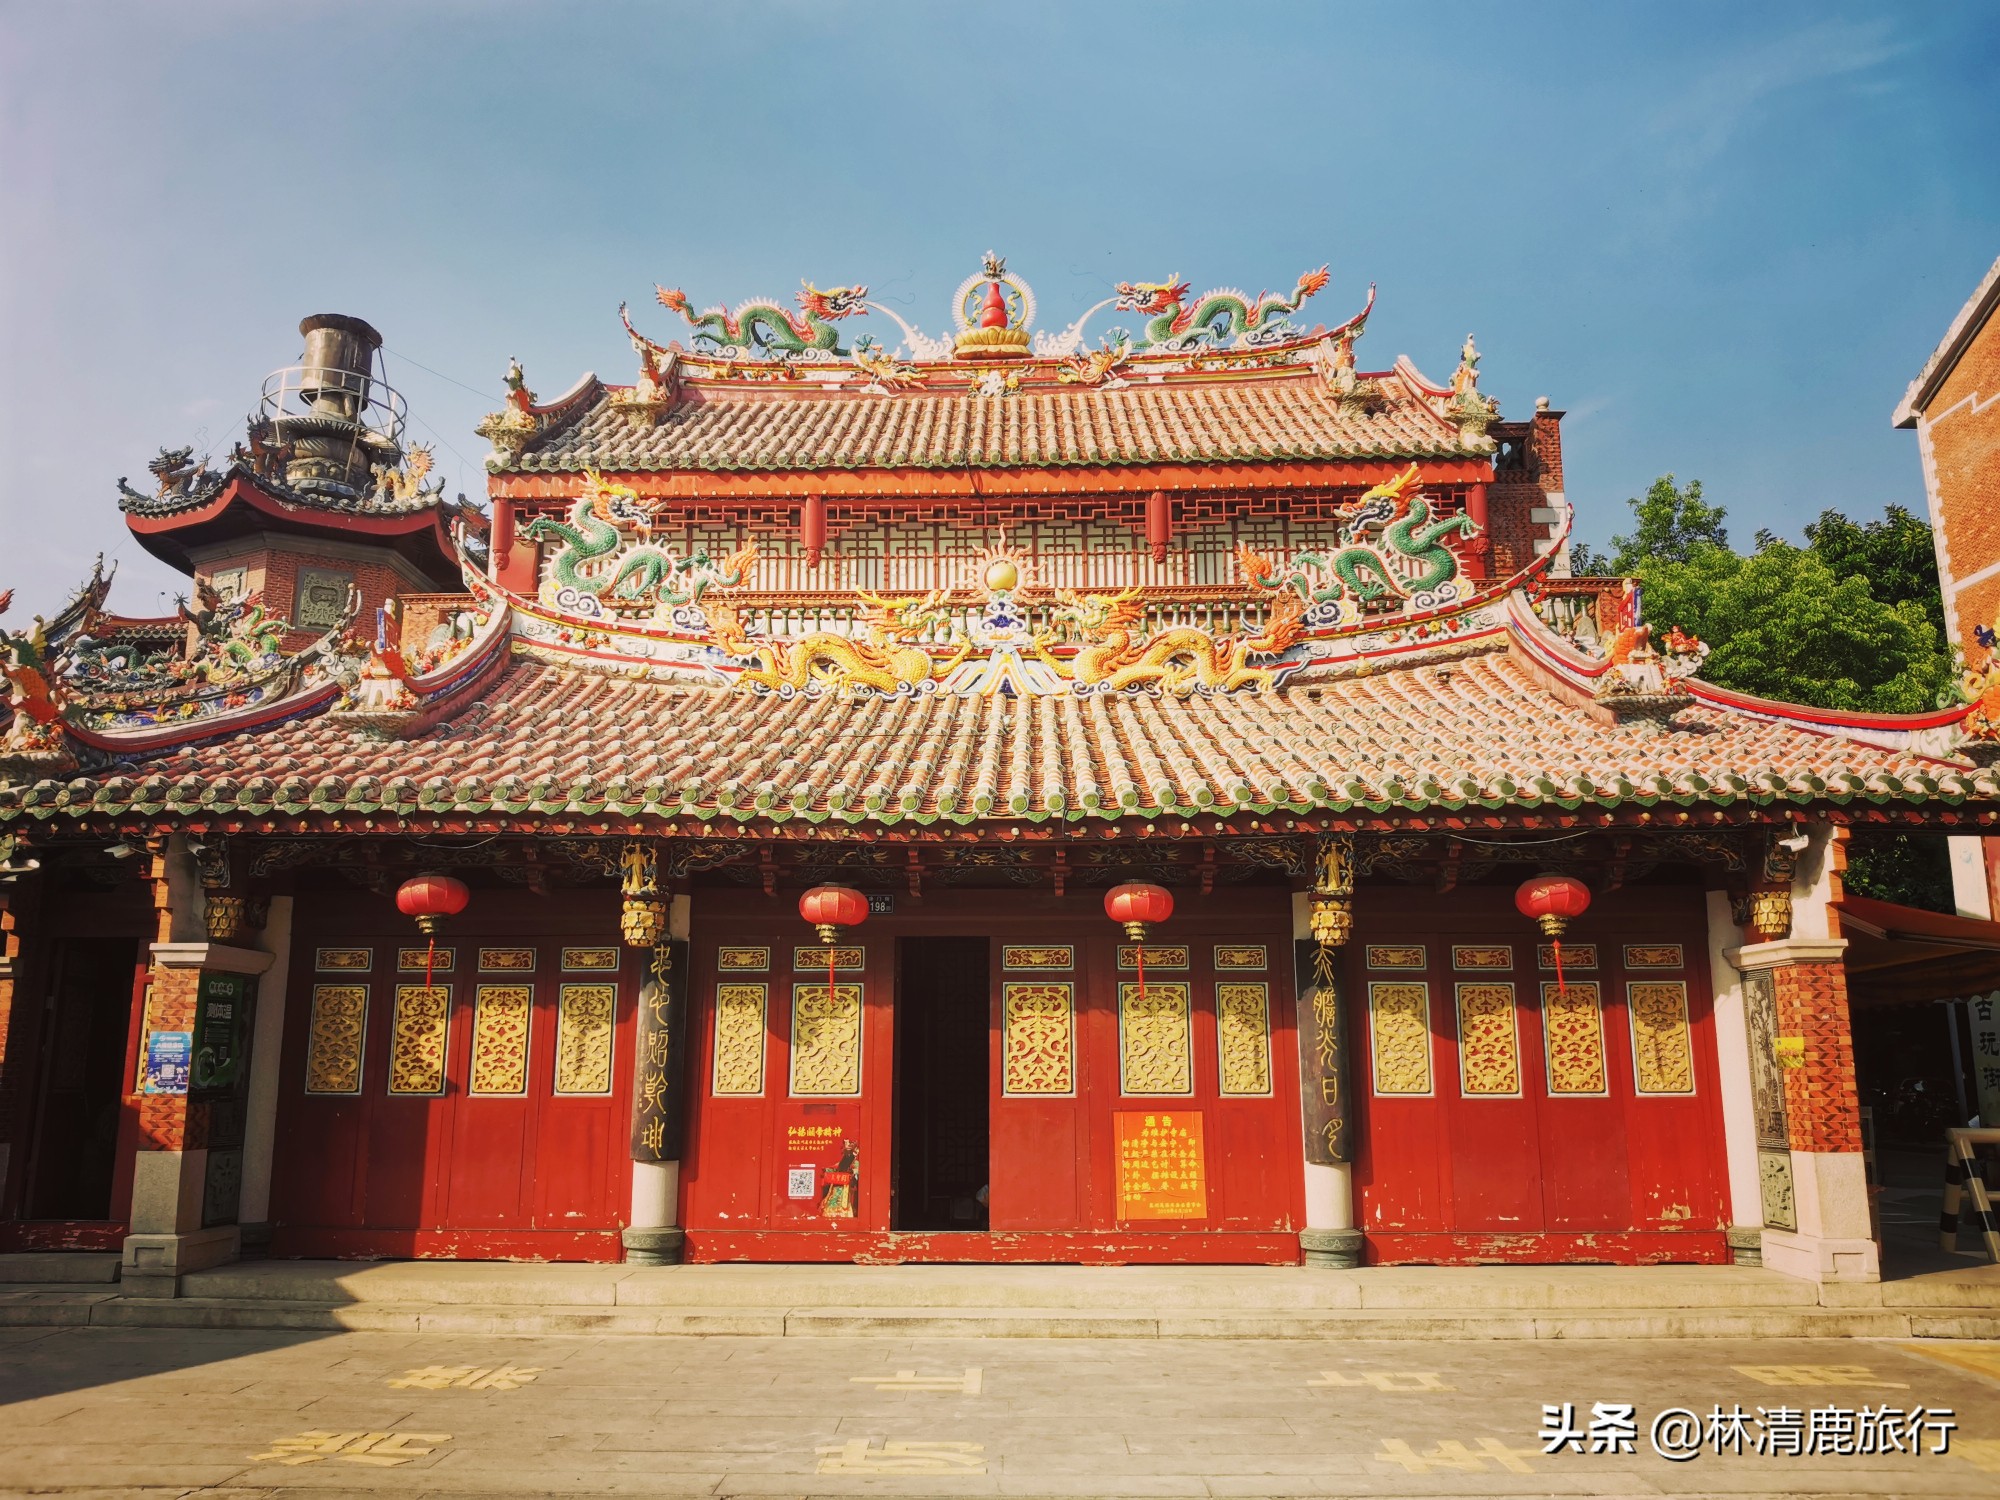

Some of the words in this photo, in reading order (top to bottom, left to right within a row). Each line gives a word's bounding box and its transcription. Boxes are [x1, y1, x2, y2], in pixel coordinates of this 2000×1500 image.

[206, 1003, 232, 1019] 测体温
[1975, 998, 2000, 1091] 古玩街
